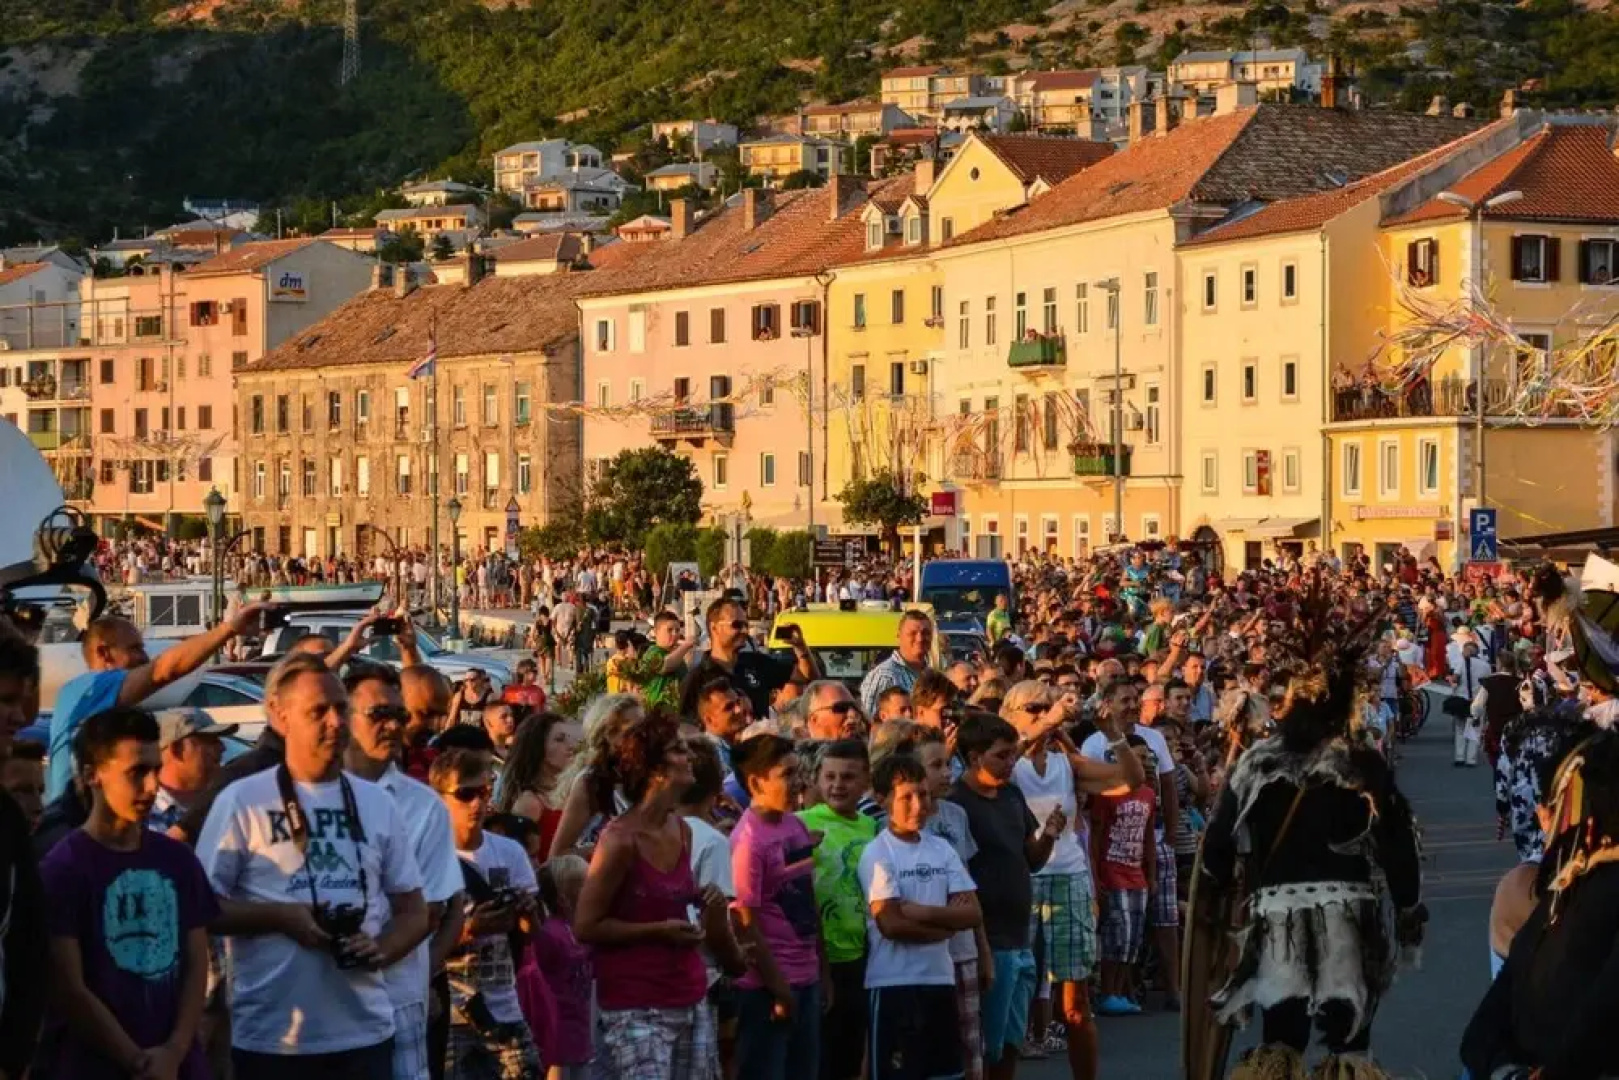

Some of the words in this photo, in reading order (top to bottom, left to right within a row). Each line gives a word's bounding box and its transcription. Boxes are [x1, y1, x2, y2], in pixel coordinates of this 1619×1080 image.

[280, 272, 302, 288] dm
[1476, 514, 1490, 532] P
[267, 807, 368, 843] KPP
